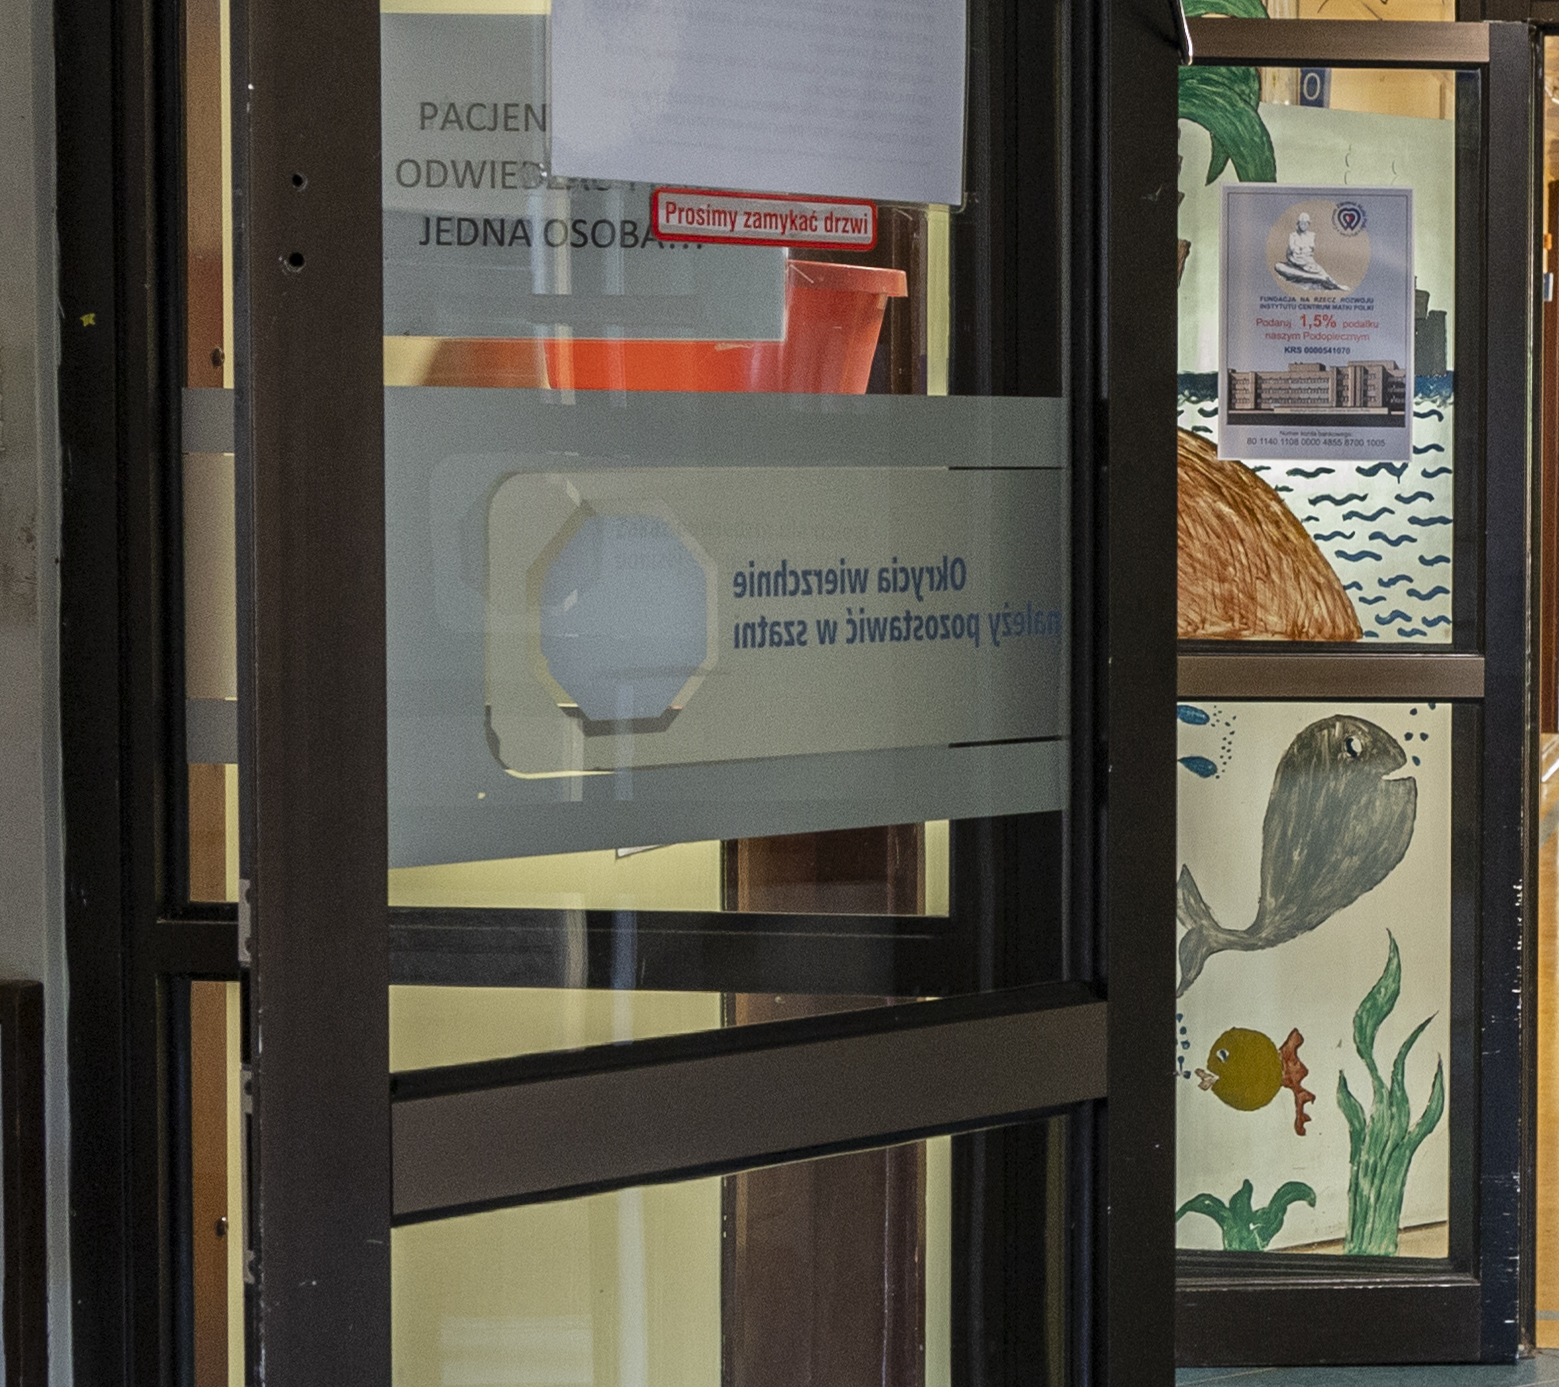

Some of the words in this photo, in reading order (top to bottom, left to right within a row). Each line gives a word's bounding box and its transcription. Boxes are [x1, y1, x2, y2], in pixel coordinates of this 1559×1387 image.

[418, 101, 547, 134] PACJEN
[665, 201, 738, 233] Prosimy
[743, 209, 818, 235] zamykać
[824, 210, 868, 235] drzwi
[418, 216, 531, 248] JEDNA
[1314, 296, 1337, 304] RZECZ
[1300, 313, 1337, 329] 1,5%
[1342, 319, 1379, 329] podatku
[1265, 332, 1300, 342] naszym
[1302, 331, 1370, 342] Podopiecznym
[1284, 346, 1302, 354] KRS
[1246, 437, 1258, 445] 80
[1260, 437, 1278, 445] 1140
[1301, 438, 1320, 446] 0000
[1367, 439, 1386, 447] 1005
